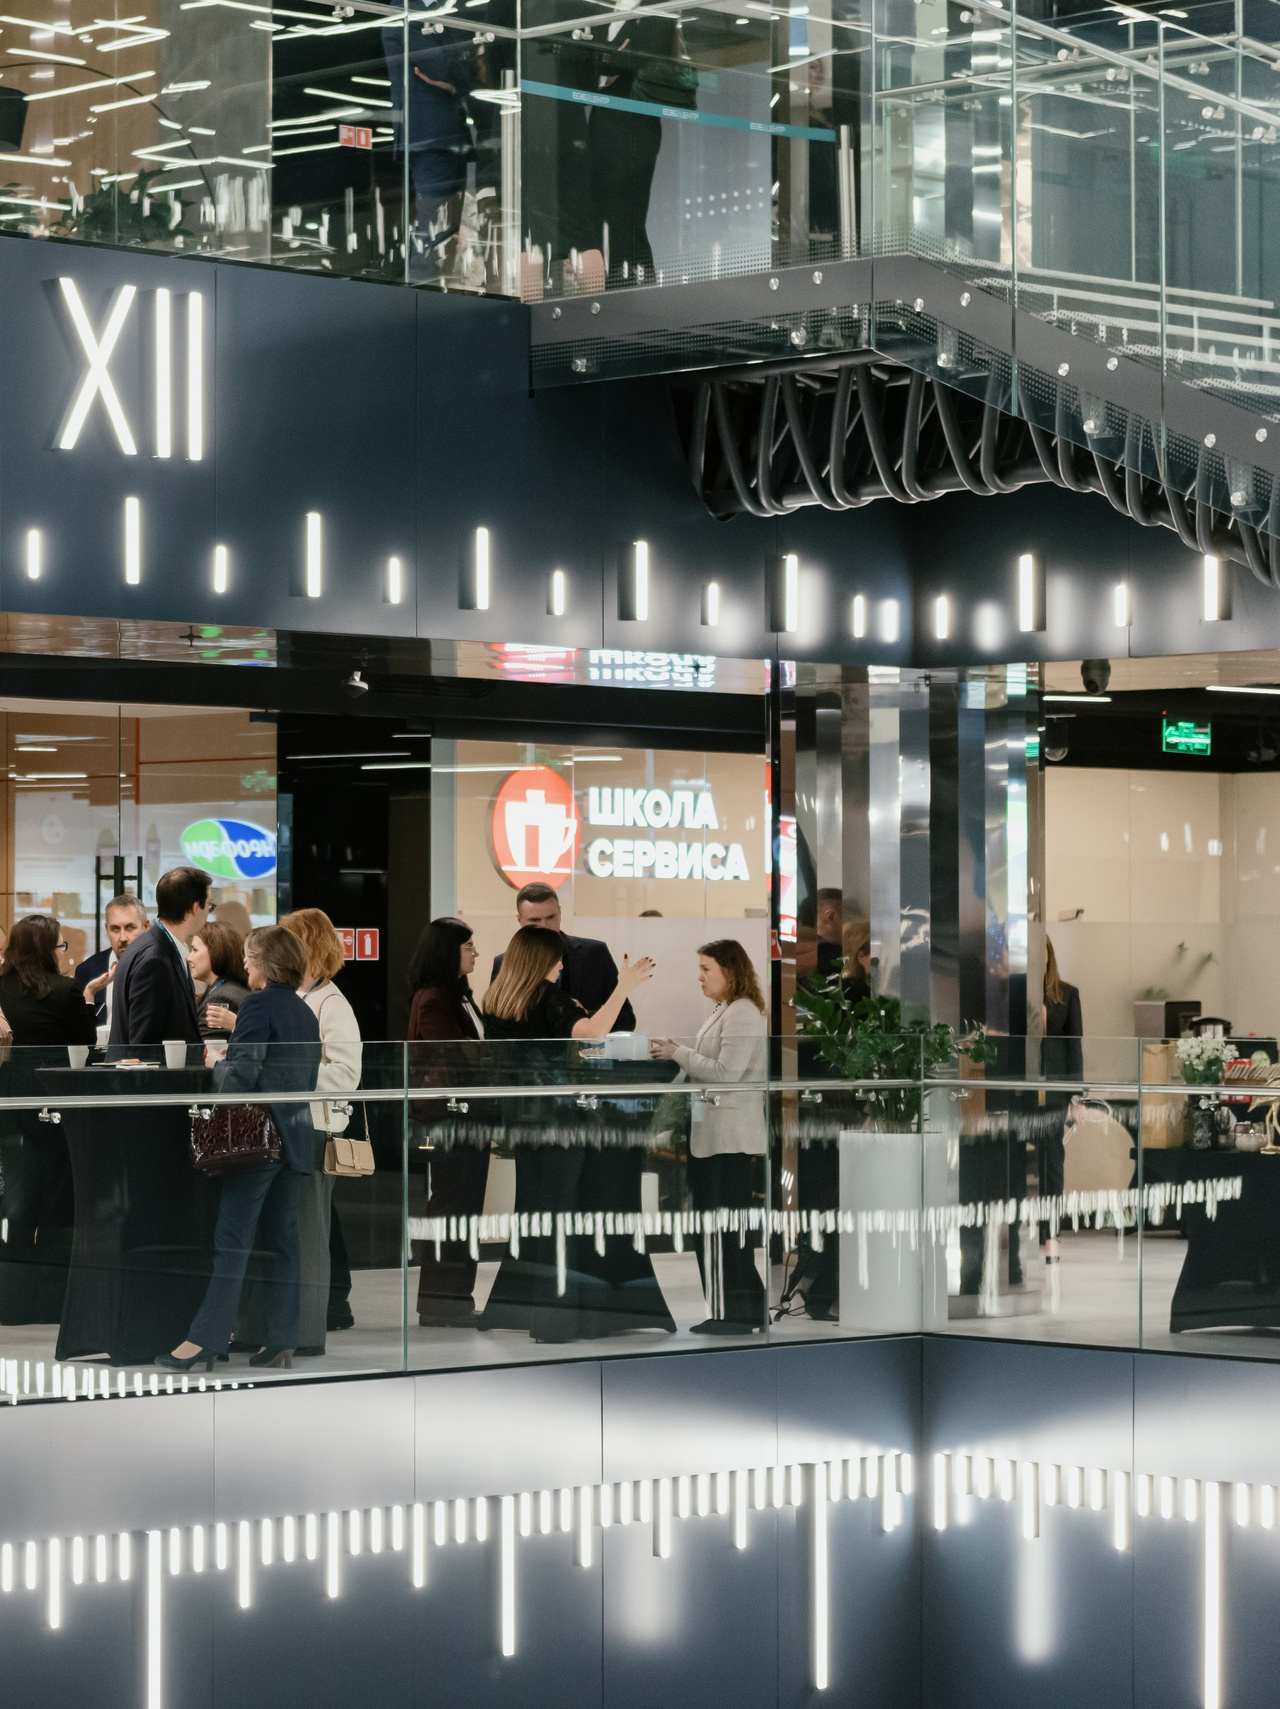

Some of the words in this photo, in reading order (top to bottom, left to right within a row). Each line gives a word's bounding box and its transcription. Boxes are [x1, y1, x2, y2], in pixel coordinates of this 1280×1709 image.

[58, 276, 203, 462] XII
[588, 786, 719, 830] ШКОЛА
[586, 838, 751, 881] СЕРВИСА
